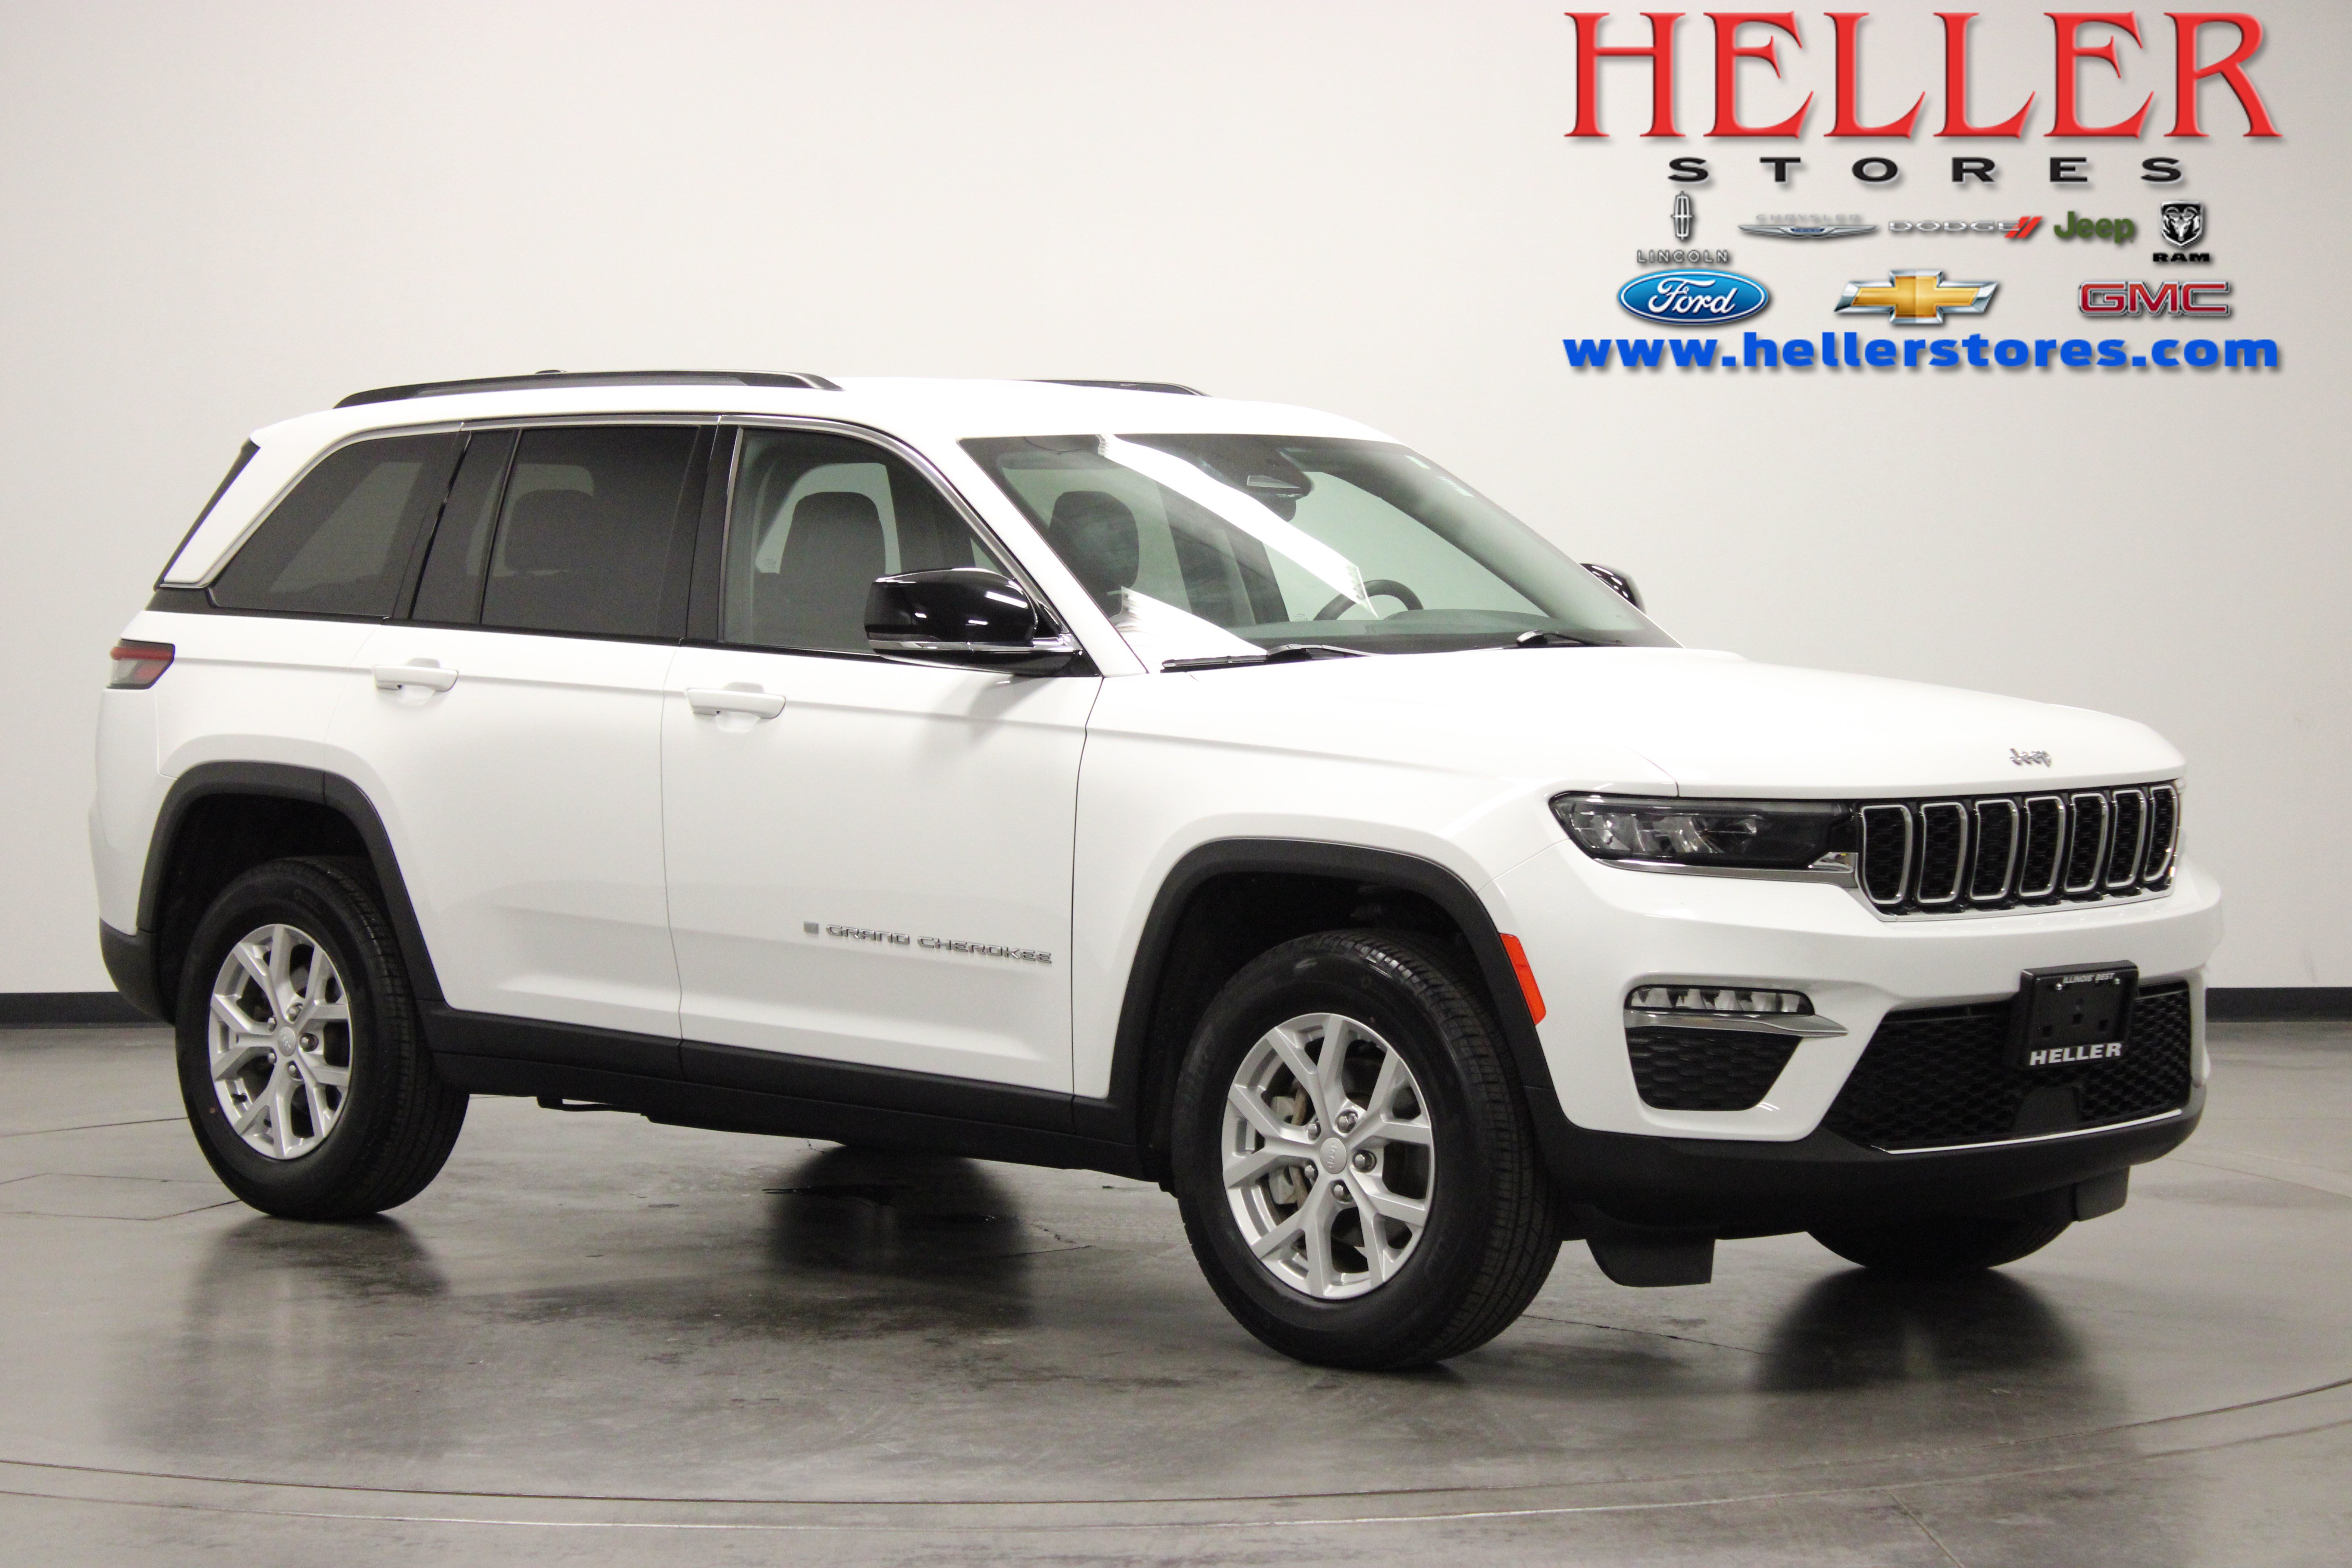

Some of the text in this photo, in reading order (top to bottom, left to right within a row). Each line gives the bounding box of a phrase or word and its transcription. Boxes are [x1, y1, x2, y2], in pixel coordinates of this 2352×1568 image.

[826, 924, 1052, 964] GRAND CHEROKEE
[2029, 1042, 2122, 1066] HELLER
